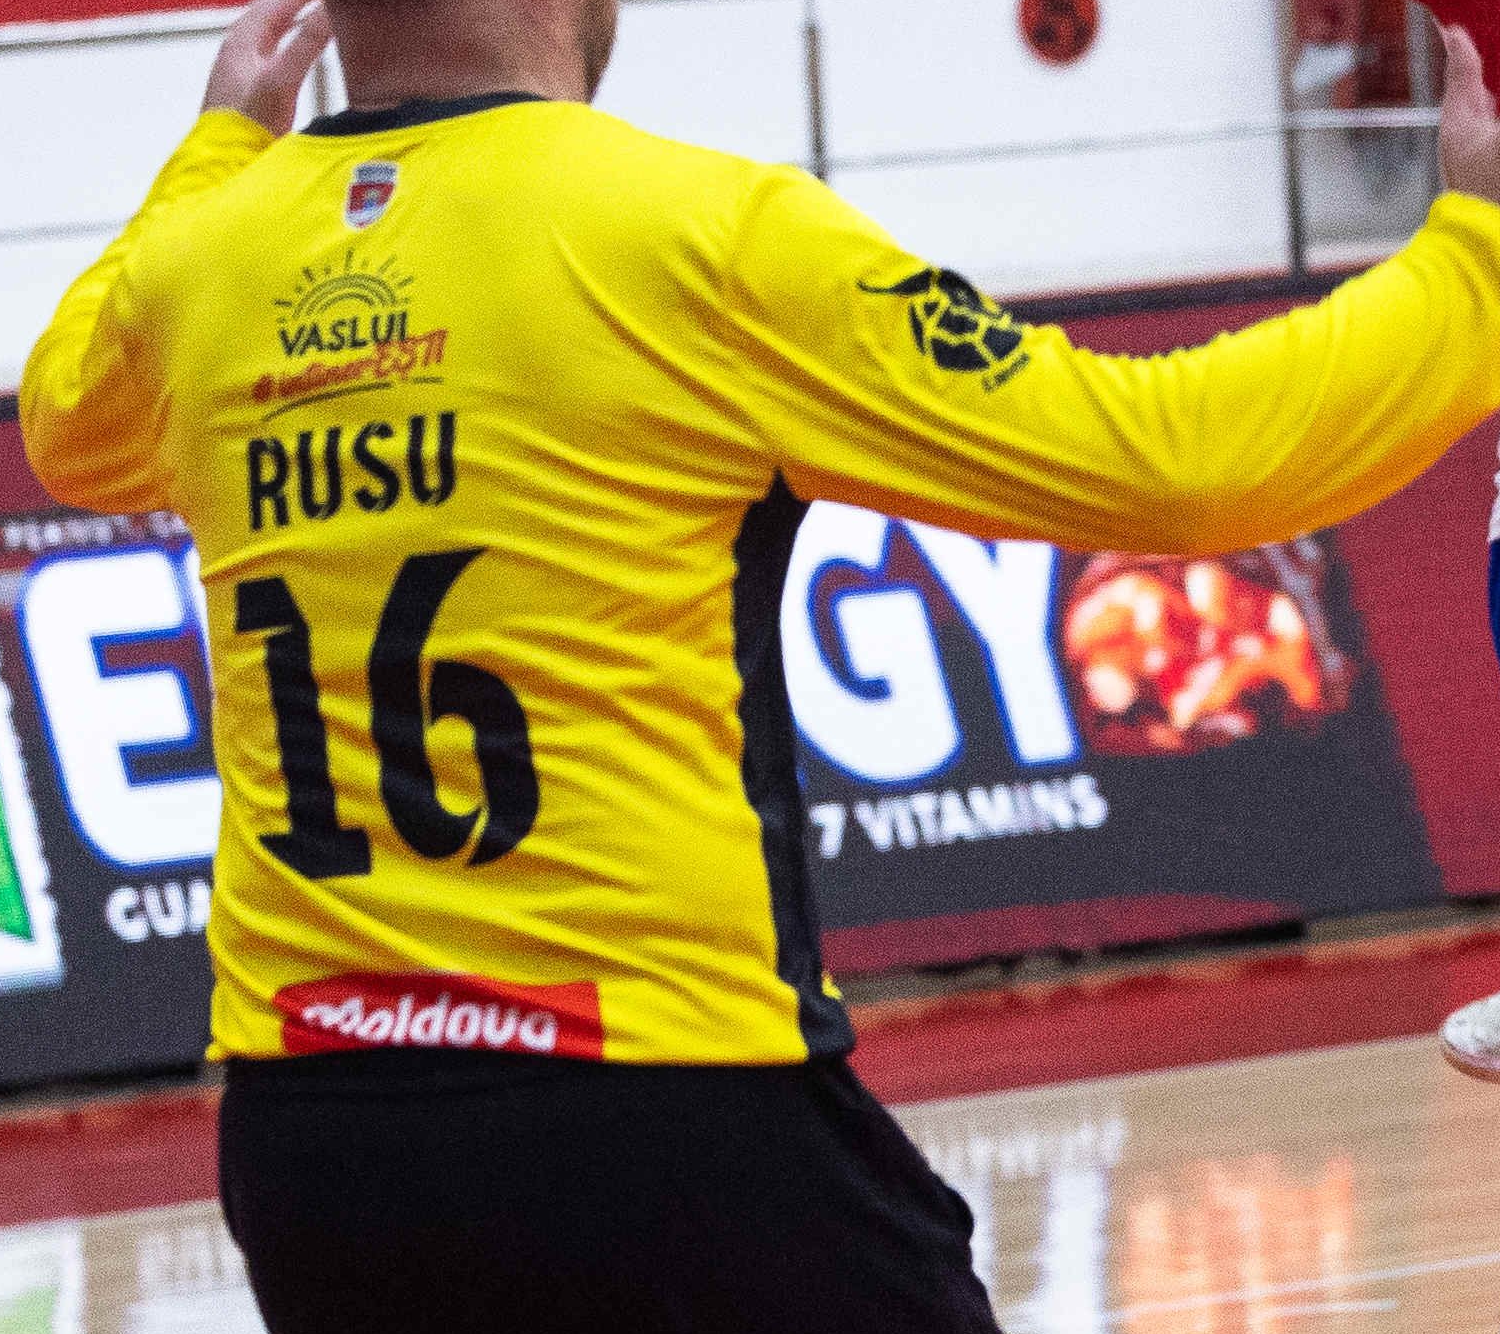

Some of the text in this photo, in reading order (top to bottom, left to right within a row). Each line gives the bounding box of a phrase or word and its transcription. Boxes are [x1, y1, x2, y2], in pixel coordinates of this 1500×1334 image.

[279, 311, 409, 357] VASLUI
[246, 411, 457, 532] RUSU
[234, 547, 541, 880] 16
[810, 774, 1109, 859] 7 VITAMINS
